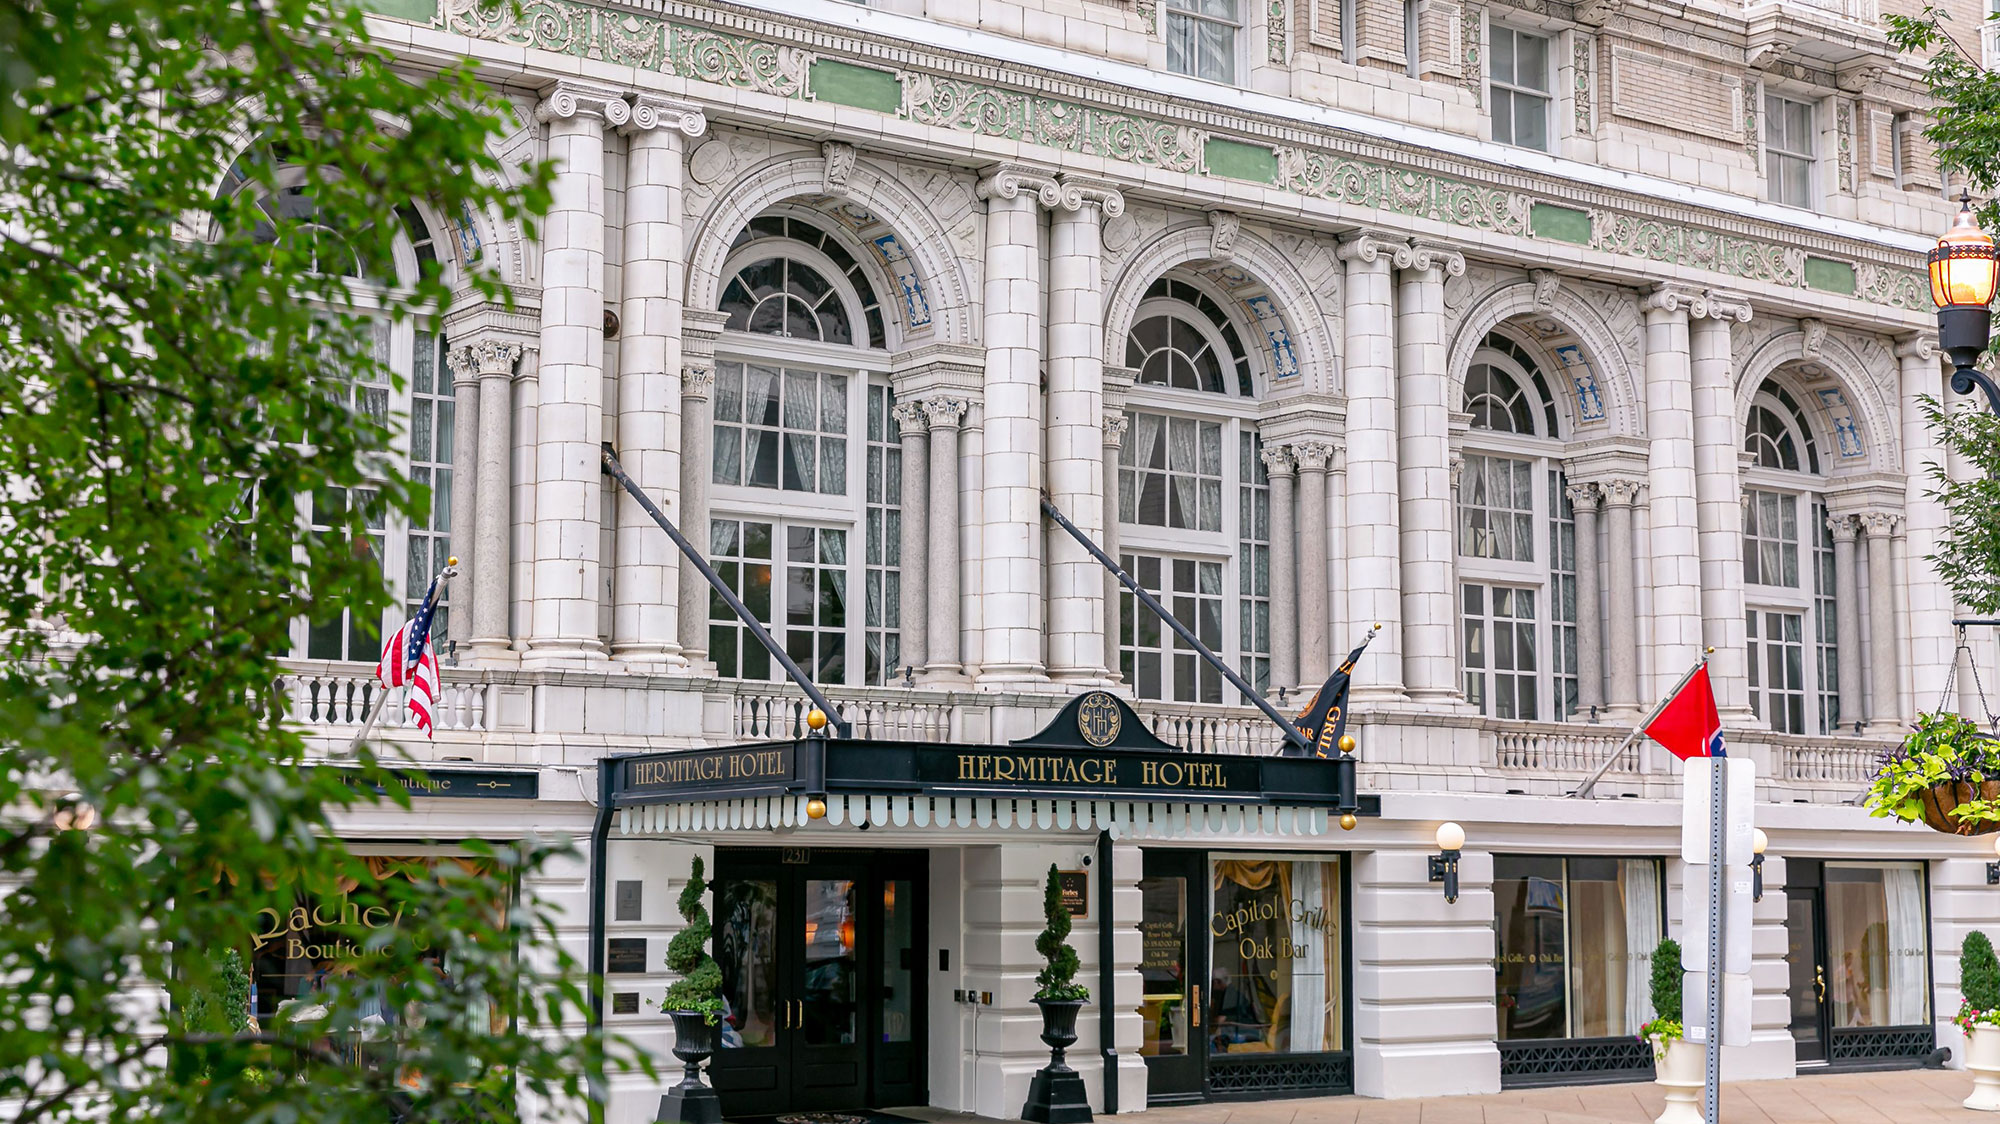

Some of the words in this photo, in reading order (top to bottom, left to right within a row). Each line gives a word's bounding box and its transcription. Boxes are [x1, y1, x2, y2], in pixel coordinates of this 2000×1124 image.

[635, 756, 723, 785] HERMITAGE
[729, 751, 785, 778] HOTEL
[957, 755, 1117, 784] HERMITAGE
[1141, 761, 1226, 788] HOTEL
[1210, 894, 1279, 936] Capitol
[1288, 899, 1337, 937] Grille
[1240, 936, 1274, 959] Oak
[1281, 938, 1309, 959] Bar
